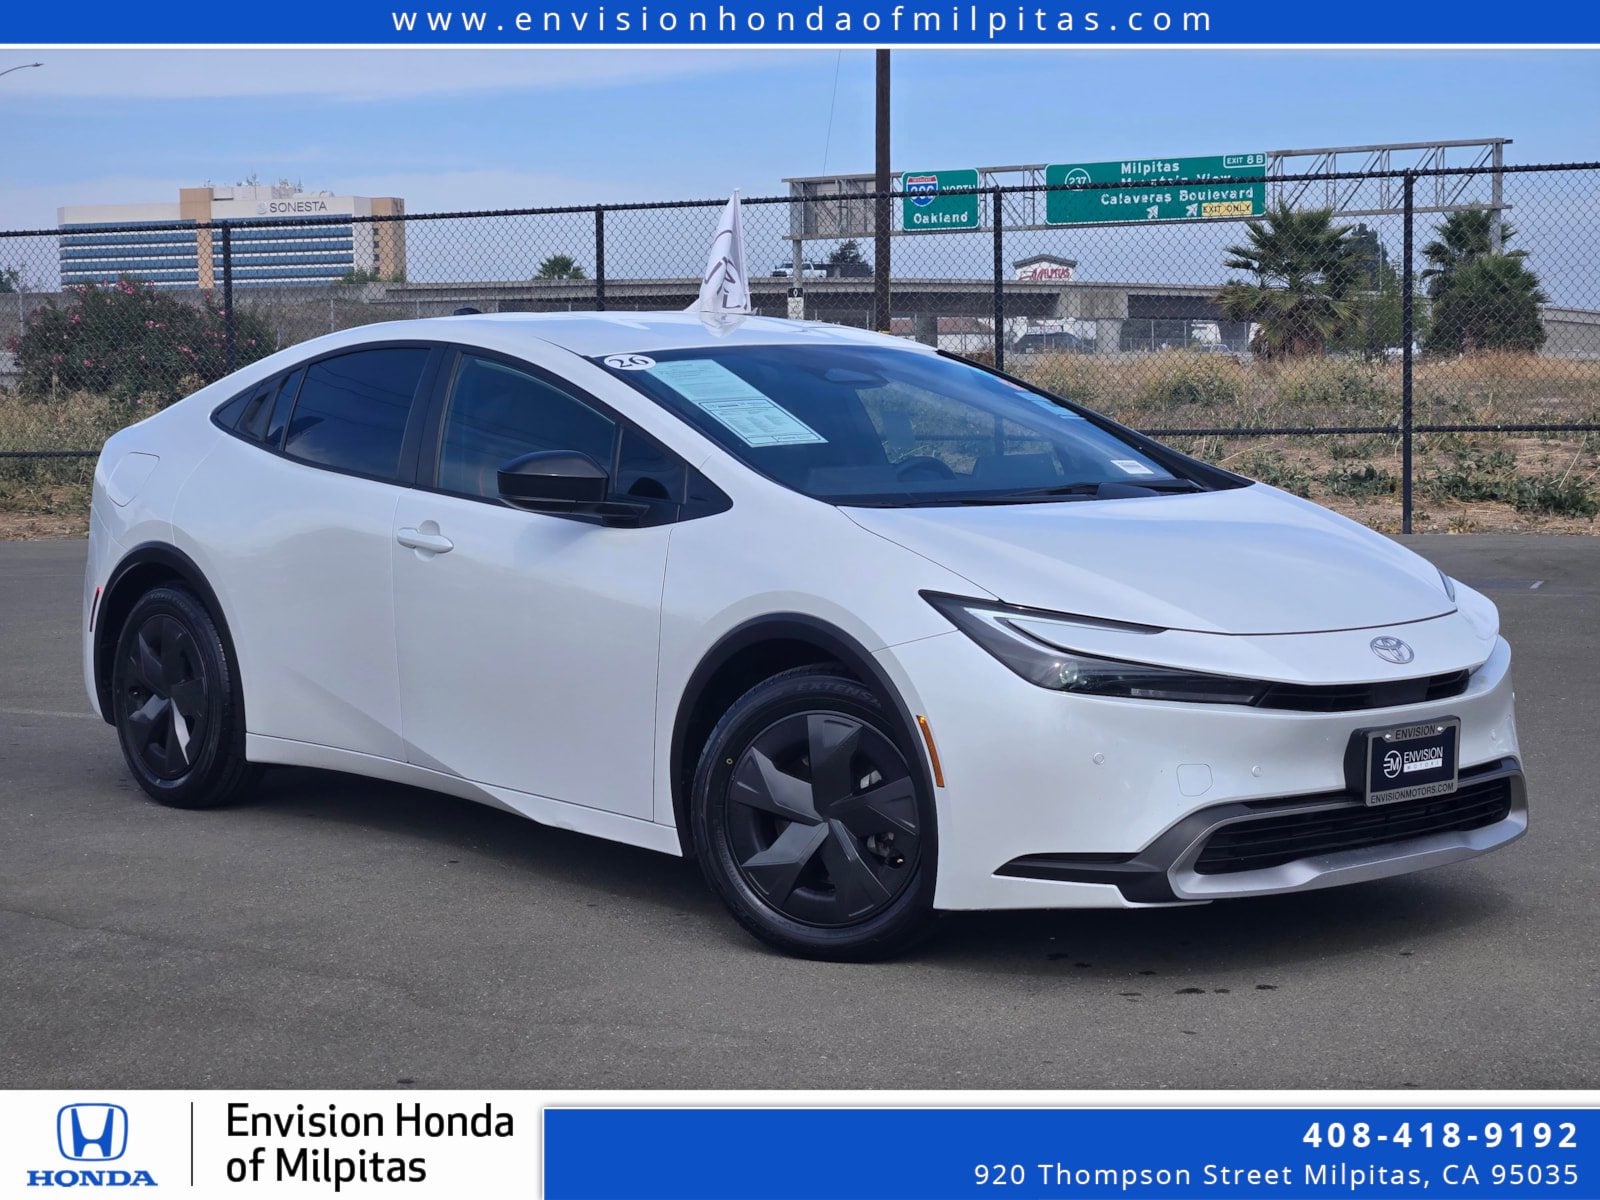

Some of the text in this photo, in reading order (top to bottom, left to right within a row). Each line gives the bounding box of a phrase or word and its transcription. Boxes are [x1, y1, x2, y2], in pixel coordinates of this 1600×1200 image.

[1226, 157, 1243, 165] EXIT
[1121, 161, 1180, 176] Milpitas
[1069, 176, 1087, 188] 237
[1101, 187, 1254, 205] Calaveras Boulevard
[269, 201, 328, 213] SONESTA
[1203, 204, 1251, 213] EXIT ONLY
[913, 211, 968, 224] Oakland
[608, 355, 649, 368] 26
[1395, 725, 1436, 740] ENVISION
[1403, 746, 1444, 764] ENVISION
[1371, 782, 1454, 804] ENVISIONMOTORS.COM
